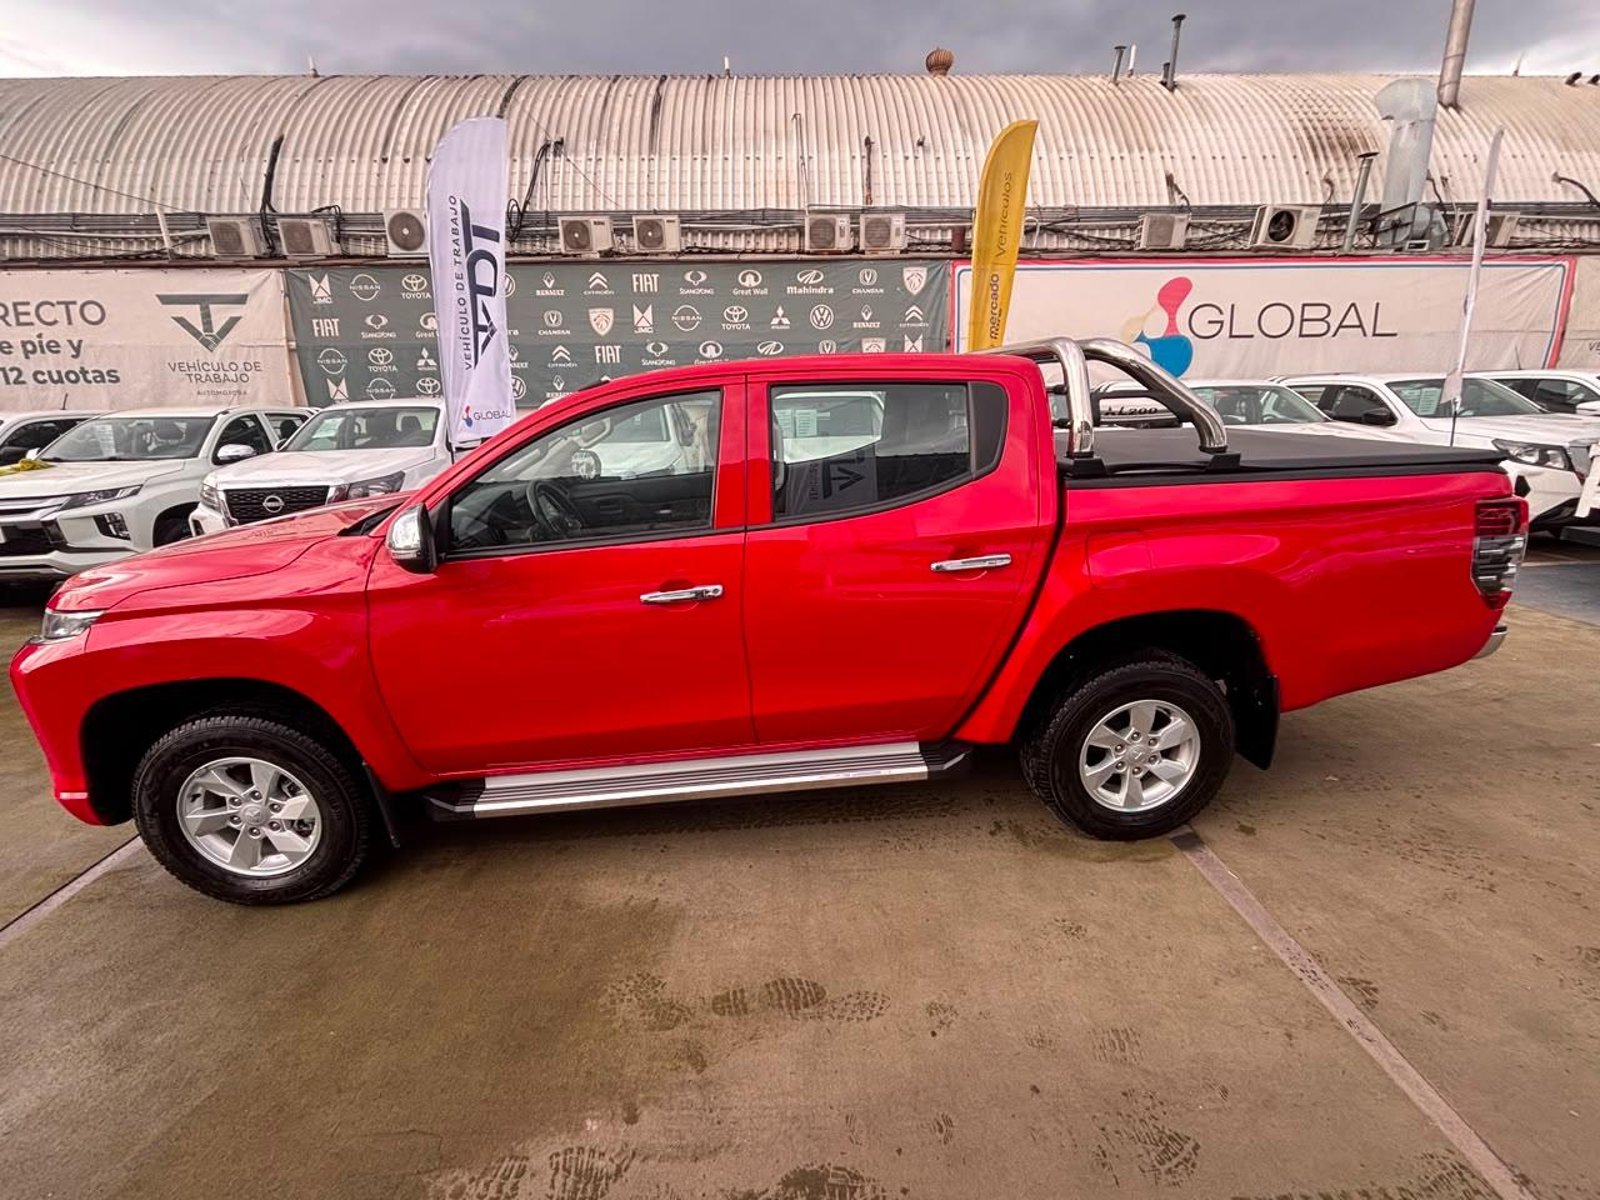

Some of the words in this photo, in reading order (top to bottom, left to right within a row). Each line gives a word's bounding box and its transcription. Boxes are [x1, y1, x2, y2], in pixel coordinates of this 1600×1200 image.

[448, 195, 462, 267] TRABAJO
[455, 271, 465, 292] DE
[631, 273, 660, 293] FIAT
[786, 286, 835, 295] Mahindra
[401, 291, 432, 300] TOYOTA
[732, 287, 751, 296] Great
[753, 287, 769, 295] Wall
[989, 274, 1000, 340] mercado
[311, 318, 340, 337] FIAT
[722, 323, 751, 331] TOYOTA
[1187, 302, 1398, 340] GLOBAL
[456, 297, 472, 371] VEHÍCULO
[66, 340, 84, 359] y
[594, 345, 622, 364] FIAT
[167, 359, 239, 373] VEHÍCULO
[243, 361, 263, 372] DE
[368, 365, 398, 373] TOYOTA
[0, 366, 27, 386] 12
[32, 366, 121, 385] cuotas
[185, 373, 250, 384] TRABAJO
[473, 410, 510, 421] GLOBAL
